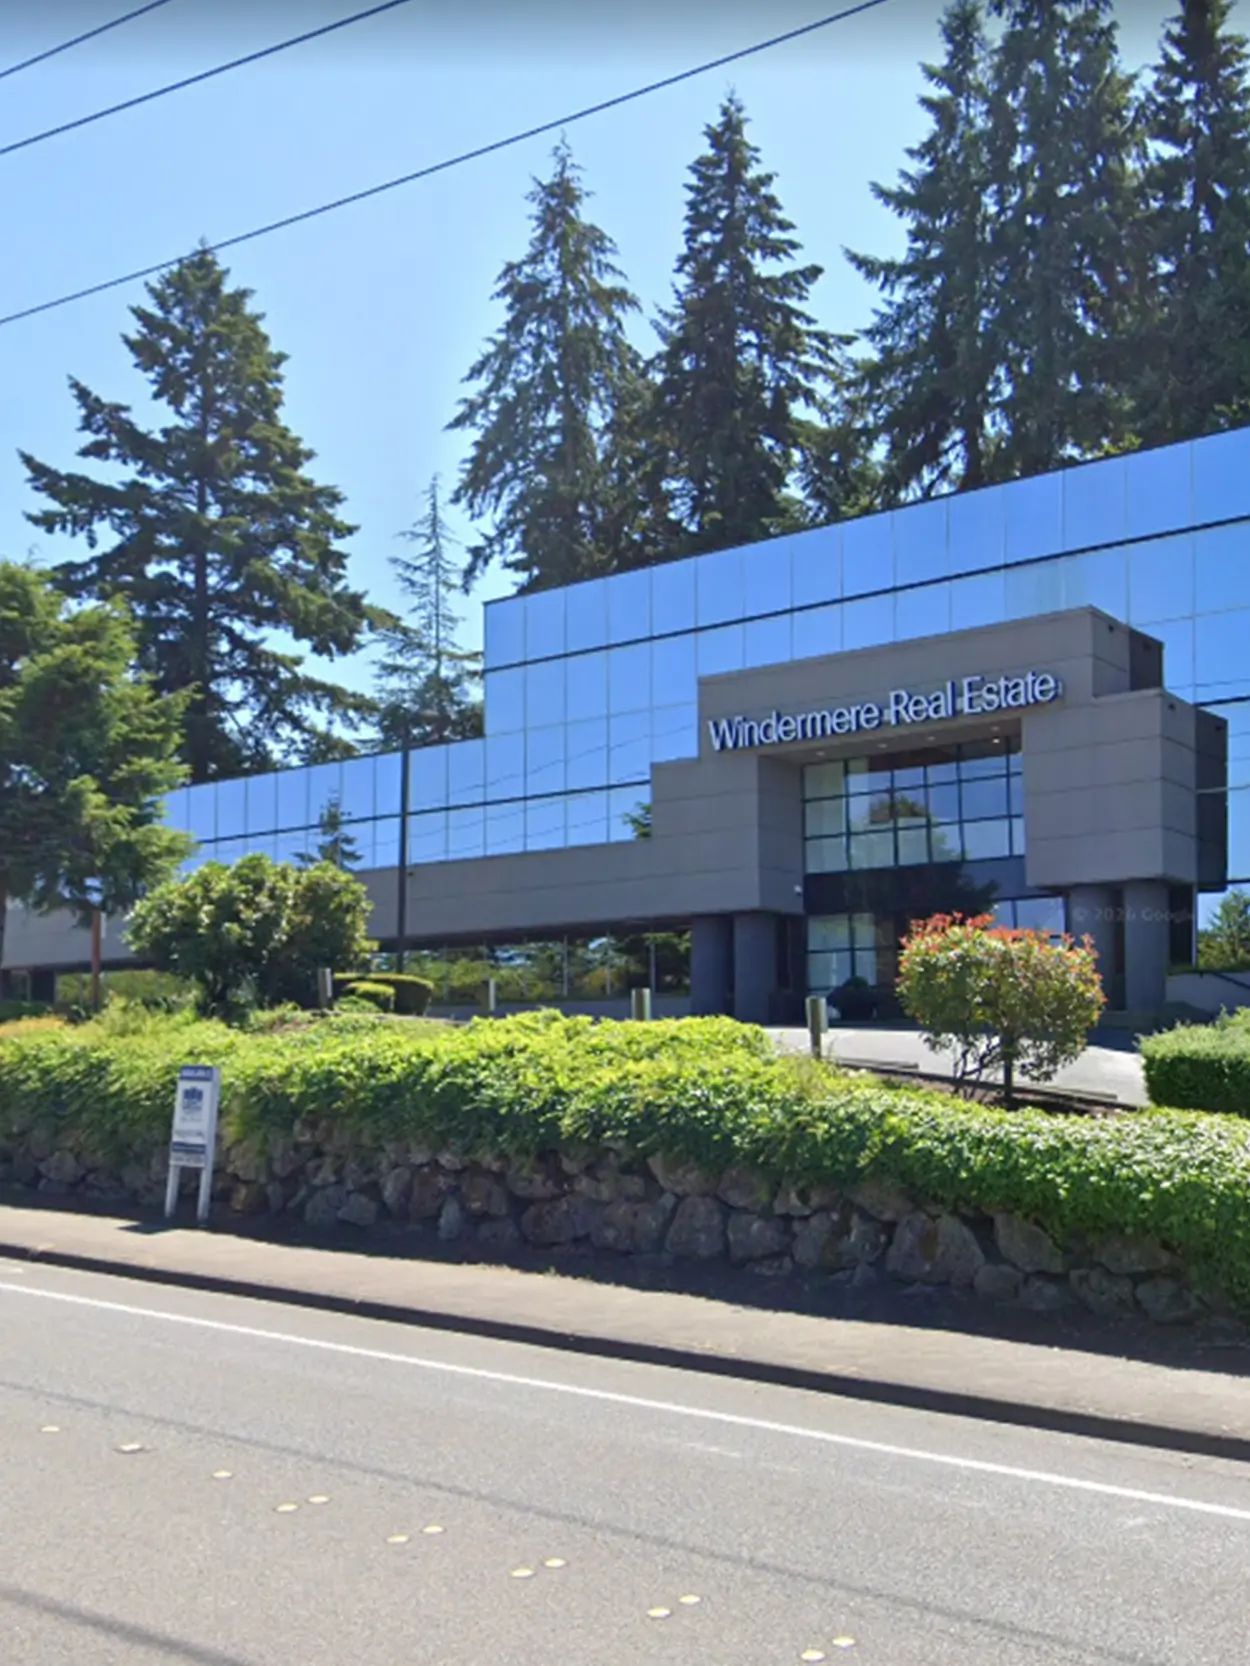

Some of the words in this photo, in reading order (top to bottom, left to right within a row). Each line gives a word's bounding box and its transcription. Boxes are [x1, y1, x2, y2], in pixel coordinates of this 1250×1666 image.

[708, 702, 881, 751] Windermere
[889, 681, 955, 725] Real
[962, 670, 1057, 714] Estate
